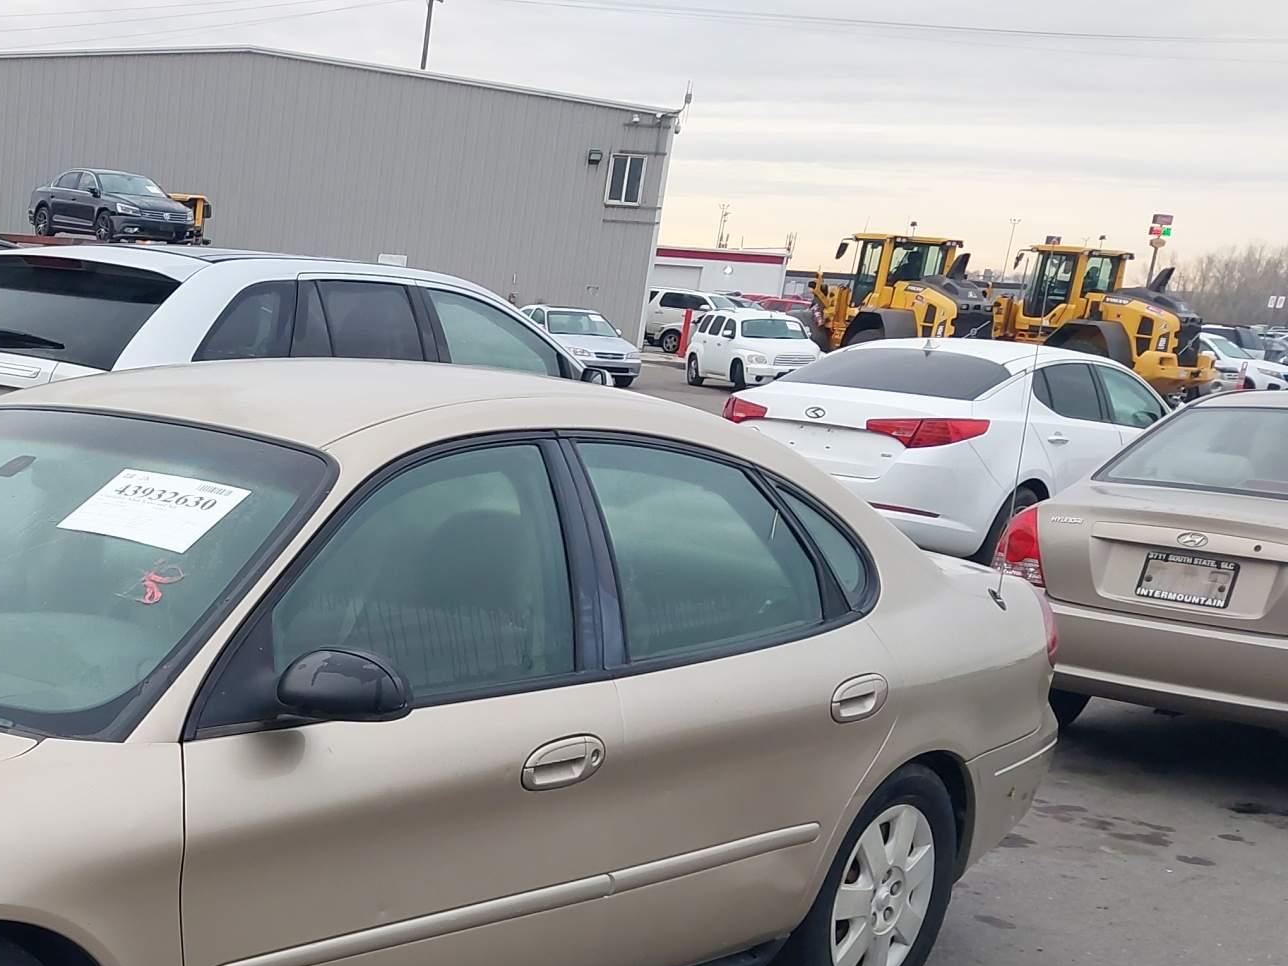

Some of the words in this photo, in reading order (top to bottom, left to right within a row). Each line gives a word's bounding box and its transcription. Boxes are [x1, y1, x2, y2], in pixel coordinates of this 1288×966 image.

[114, 483, 217, 511] 43932630
[1148, 551, 1167, 560] 3711
[1168, 554, 1192, 565] SOUTH
[1220, 561, 1236, 570] SLC
[1136, 587, 1226, 608] INTERMOUNTAIN
